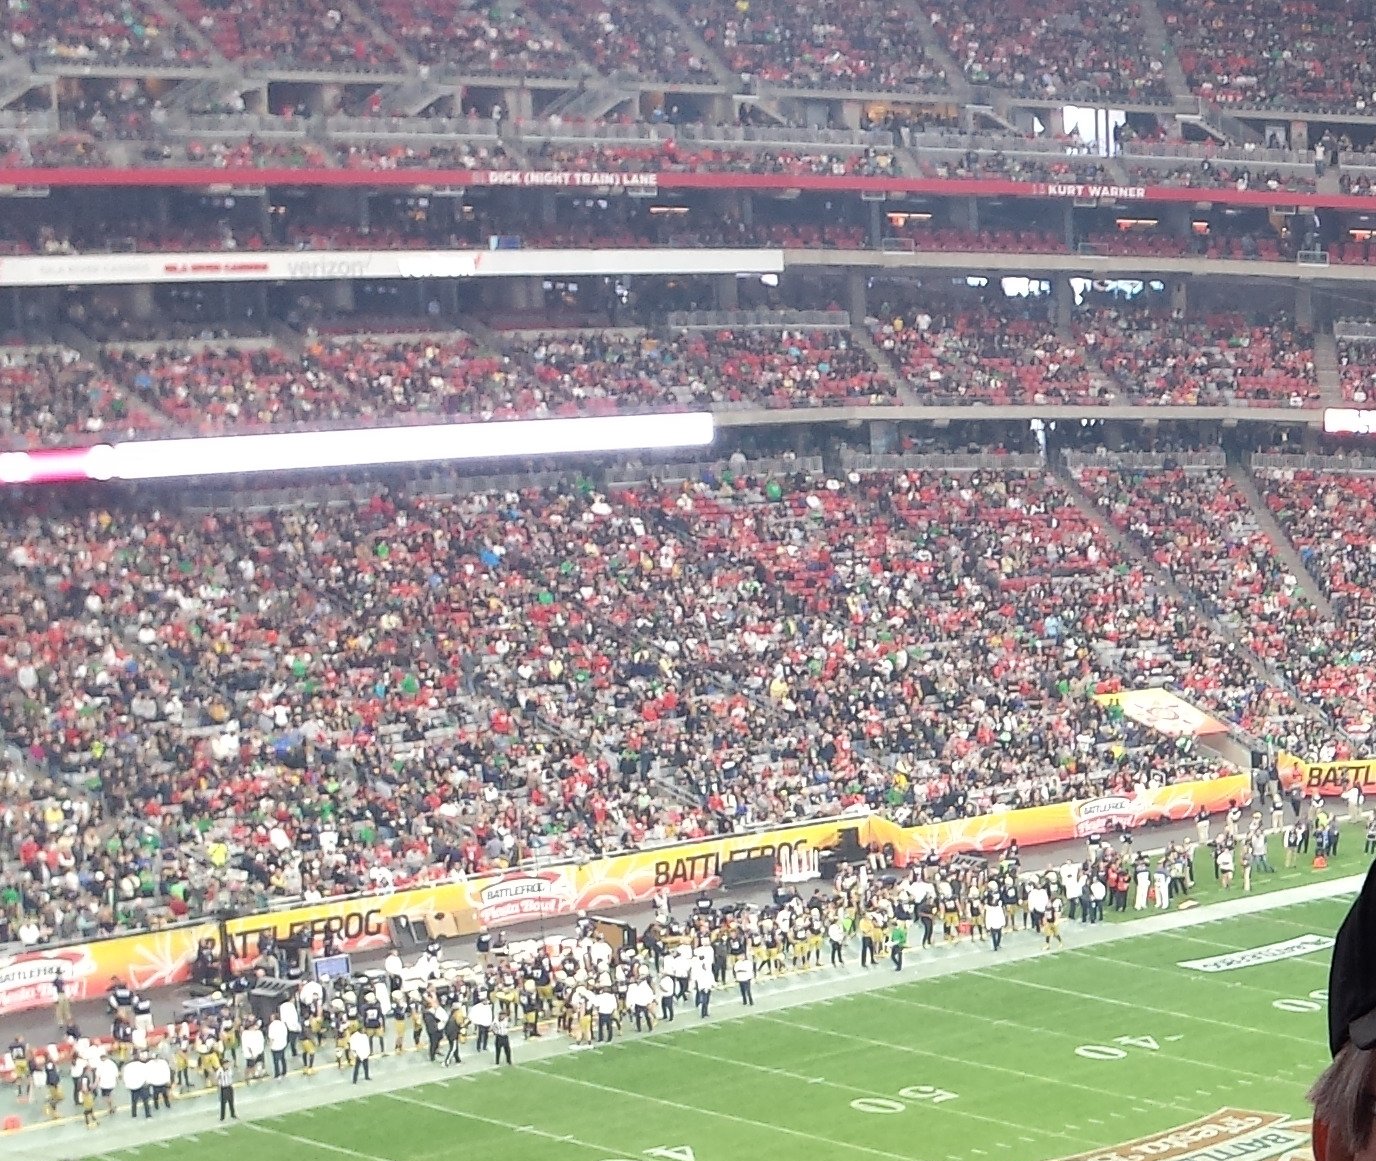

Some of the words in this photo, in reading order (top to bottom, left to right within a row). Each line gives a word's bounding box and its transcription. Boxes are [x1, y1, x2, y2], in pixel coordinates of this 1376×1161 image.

[489, 172, 520, 185] DICK
[524, 172, 570, 186] (NIGHT
[575, 172, 619, 186] TRAIN)
[623, 172, 657, 185] LANE
[1048, 184, 1084, 196] KURT
[1088, 185, 1146, 198] WARNER
[1075, 1034, 1160, 1060] 40
[850, 1085, 959, 1114] 50
